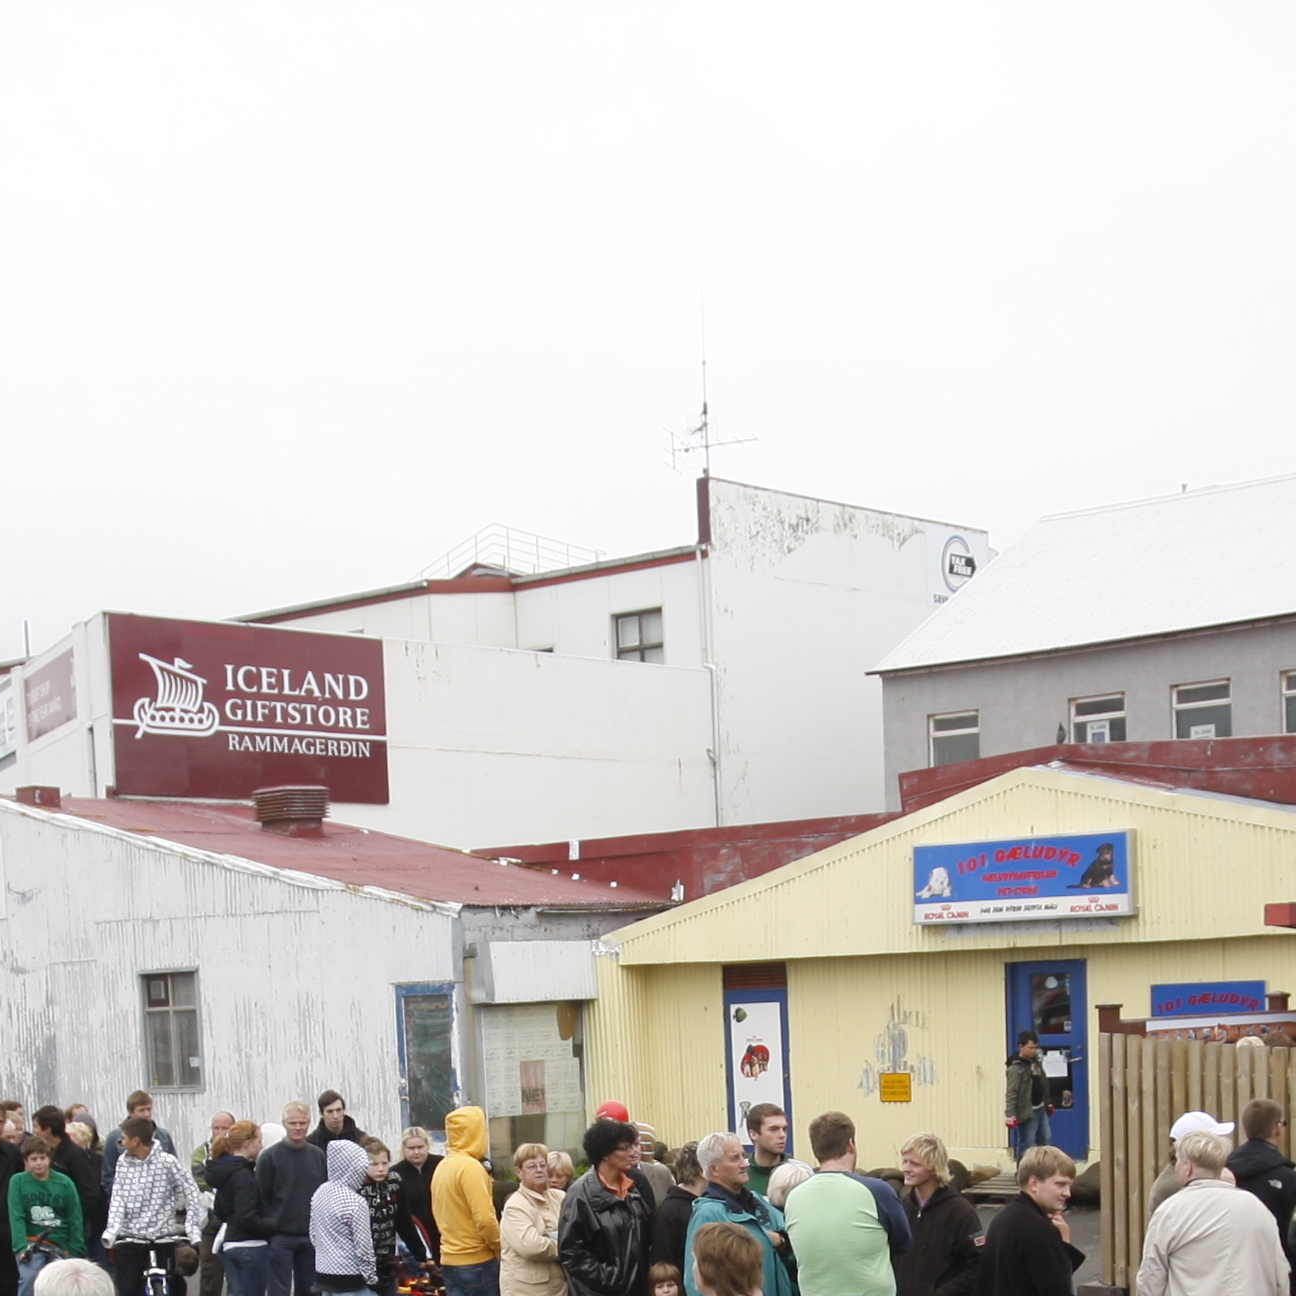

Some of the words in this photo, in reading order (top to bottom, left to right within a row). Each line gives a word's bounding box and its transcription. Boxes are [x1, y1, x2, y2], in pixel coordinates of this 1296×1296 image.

[224, 664, 369, 700] ICELAND
[225, 699, 370, 729] GIFTSTORE
[228, 734, 370, 757] RAMMAGERÐIN
[957, 853, 988, 875] 101
[994, 844, 1082, 868] GÆLUDÝR
[1158, 998, 1181, 1014] 101
[1188, 992, 1260, 1011] GÆLUDÝR
